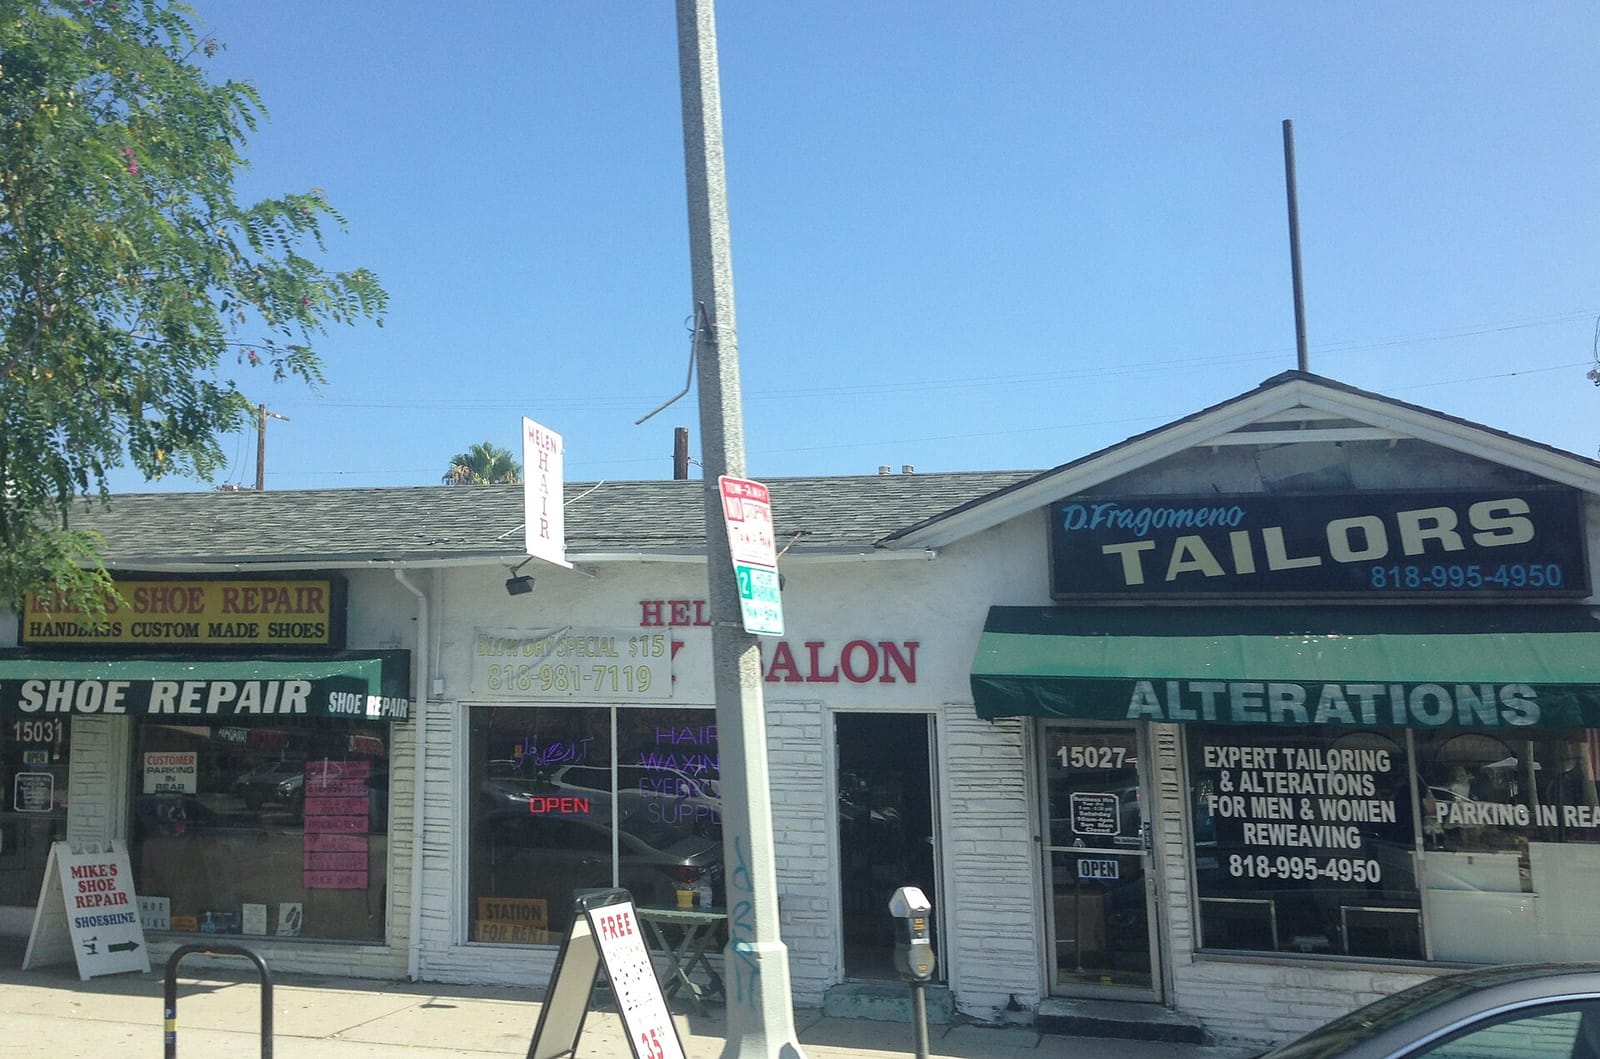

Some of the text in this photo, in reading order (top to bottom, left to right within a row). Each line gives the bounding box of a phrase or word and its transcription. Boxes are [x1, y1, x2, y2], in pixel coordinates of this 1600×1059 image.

[528, 426, 557, 455] HELEN
[538, 449, 550, 540] HAIR
[1102, 498, 1535, 586] TAILORS
[740, 571, 750, 595] 2
[1370, 564, 1562, 589] 818-995-4950
[133, 587, 204, 614] SHOE
[221, 587, 325, 614] REPAIR
[640, 600, 712, 626] HEL
[131, 622, 199, 639] CUSTOM
[208, 623, 259, 638] MADE
[268, 622, 325, 638] SHOES
[522, 636, 554, 658] DRY
[556, 635, 618, 658] SPECIAL
[629, 635, 665, 658] $15
[758, 641, 920, 684] ALON
[488, 663, 651, 692] 818-981-7119
[18, 679, 312, 714] SHOE REPAIR
[328, 691, 408, 718] SHOE REPAIR
[1127, 681, 1542, 728] ALTERATIONS
[13, 721, 63, 742] 15031
[146, 766, 194, 774] PARKING
[147, 755, 194, 766] CUSTOMER
[641, 751, 720, 774] WAXIN
[1056, 746, 1127, 769] 15027
[1204, 746, 1391, 773] EXPERT TAILORING
[155, 783, 185, 791] REAR
[1219, 770, 1376, 796] & ALTERATIONS
[529, 797, 591, 814] OPEN
[648, 801, 722, 824] SUPPL
[1207, 796, 1396, 823] FOR MEN & WOMEN
[1435, 802, 1600, 828] PARKING IN REA
[1243, 823, 1361, 849] REWEAVING
[70, 864, 118, 879] MIKE'S
[1081, 861, 1116, 877] OPEN
[1229, 855, 1381, 883] 818-995-4950
[78, 878, 116, 893] SHOE
[74, 892, 129, 909] REPAIR
[486, 903, 541, 920] STATION
[74, 912, 136, 928] SHOESHINE
[600, 912, 632, 941] FREE
